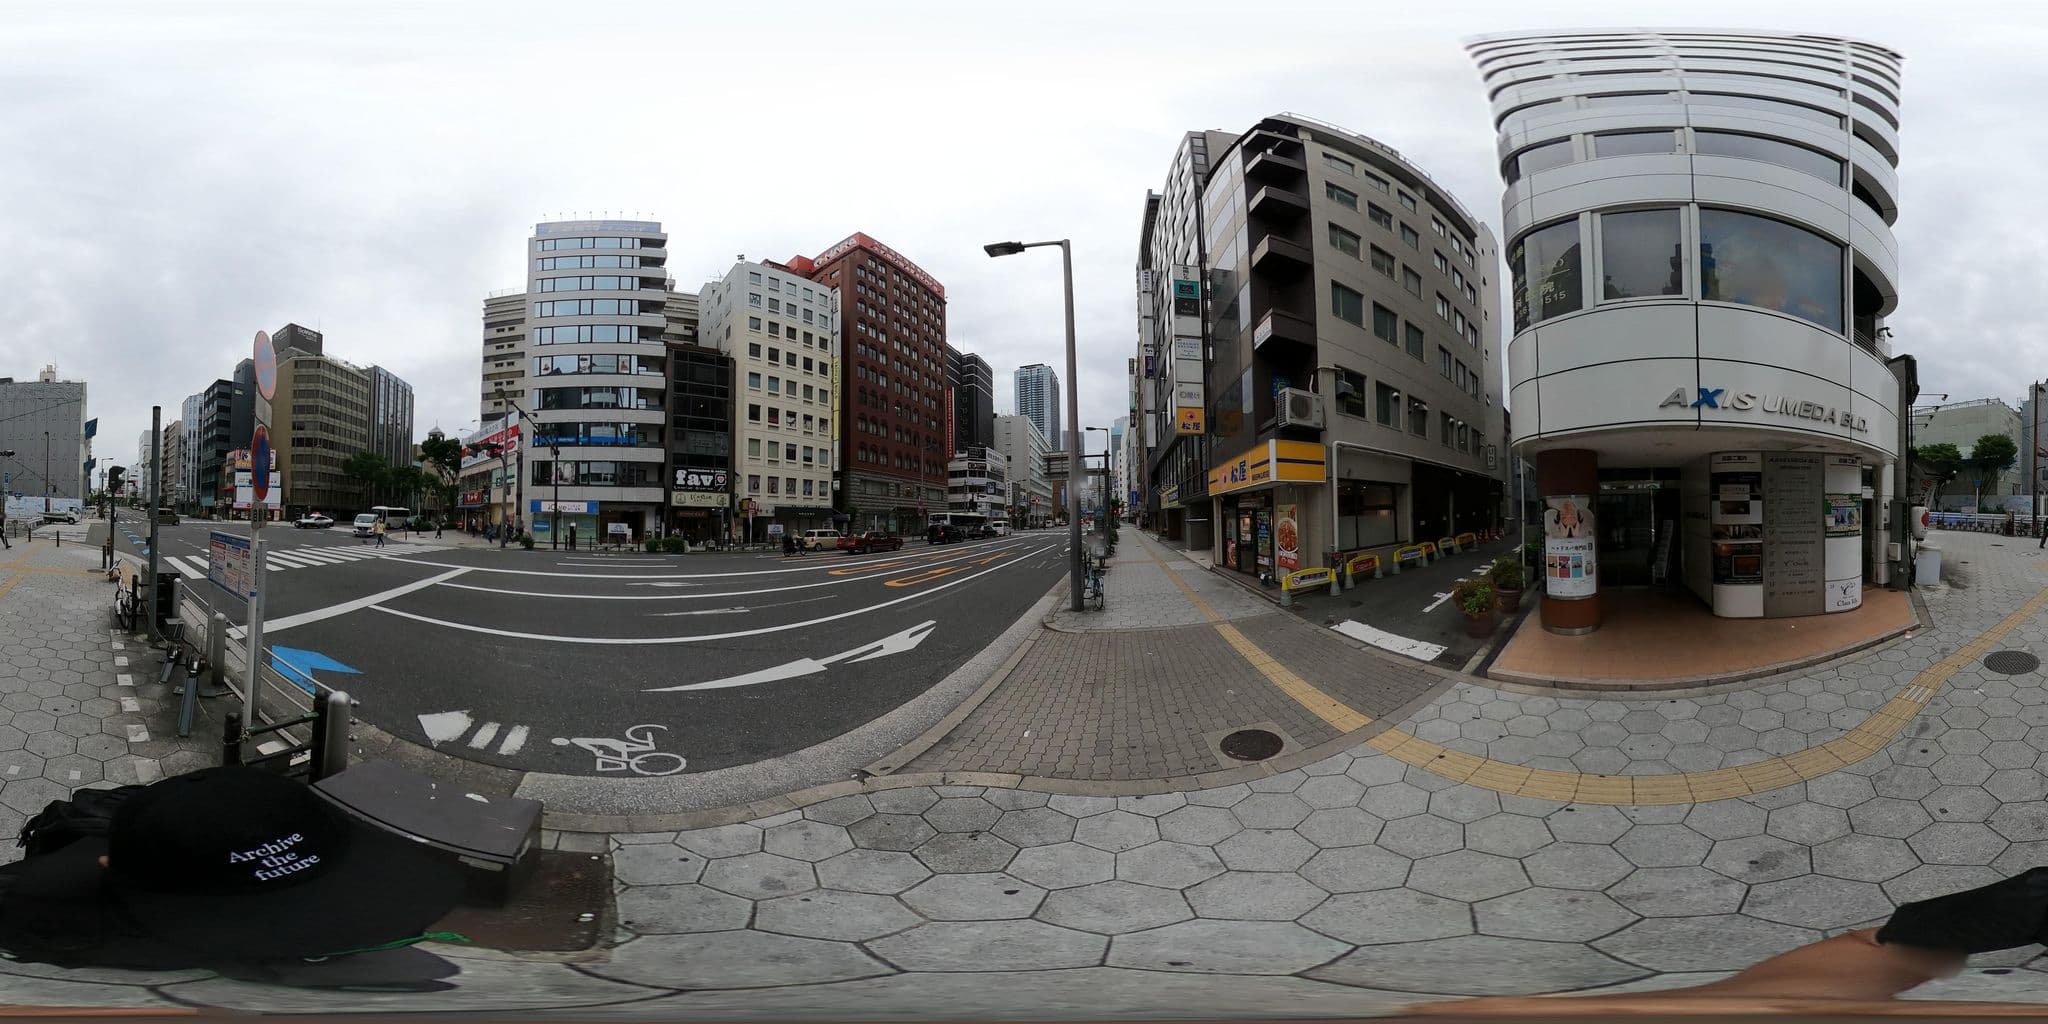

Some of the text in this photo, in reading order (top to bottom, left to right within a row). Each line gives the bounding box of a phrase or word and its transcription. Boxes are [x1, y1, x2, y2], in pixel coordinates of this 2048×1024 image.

[1659, 387, 1868, 434] AXIS UMEDA BLD.
[676, 469, 714, 486] fav
[1231, 460, 1247, 484] 松屋
[229, 833, 304, 863] Archive
[262, 852, 298, 868] the
[254, 854, 320, 881] future
